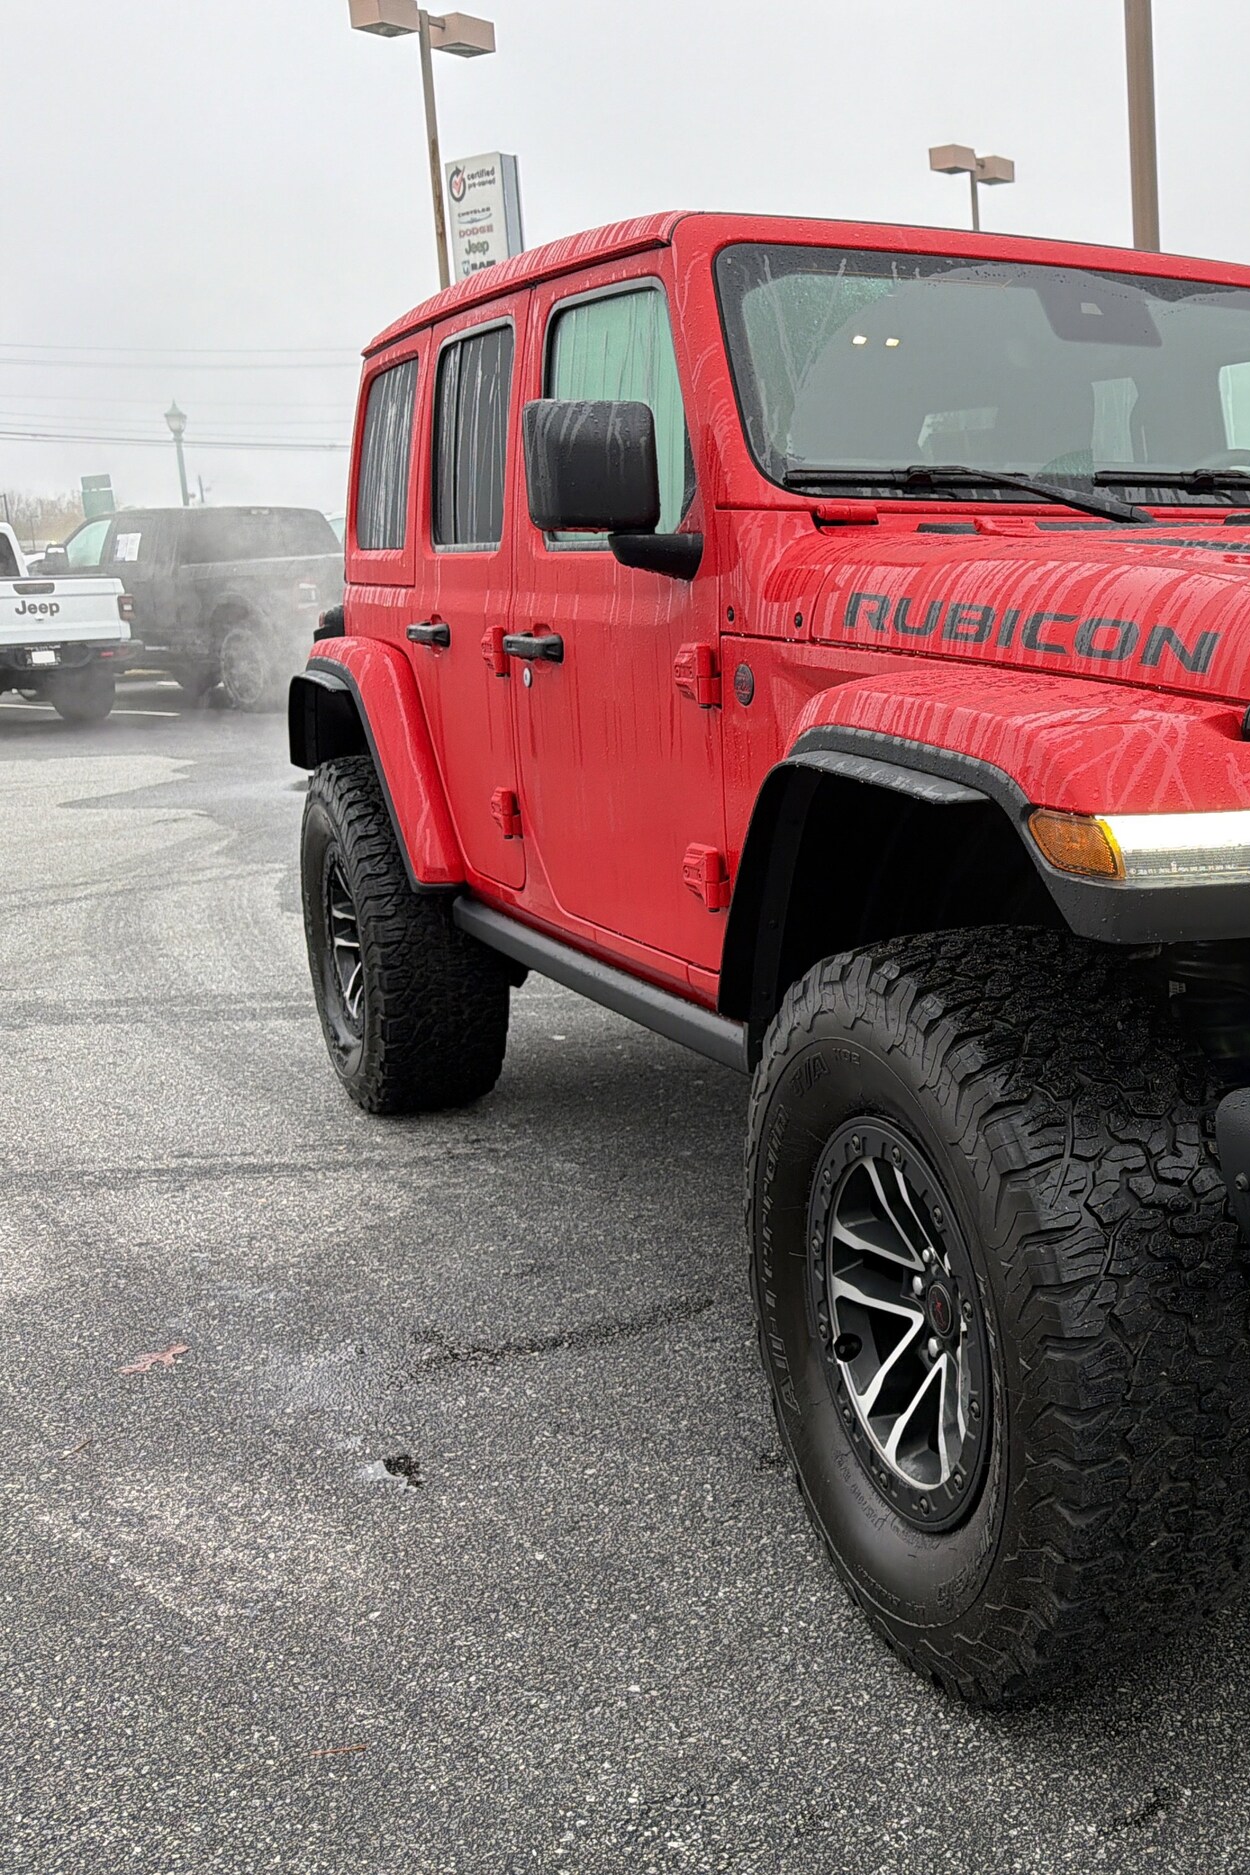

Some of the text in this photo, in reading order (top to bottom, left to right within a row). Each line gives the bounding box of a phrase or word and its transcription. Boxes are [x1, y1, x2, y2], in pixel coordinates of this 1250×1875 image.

[467, 167, 494, 180] certified
[468, 178, 495, 188] pre-owned
[459, 225, 493, 238] DODGE
[465, 239, 489, 255] Jeep
[15, 600, 60, 616] Jeep
[843, 590, 1221, 675] RUBICON
